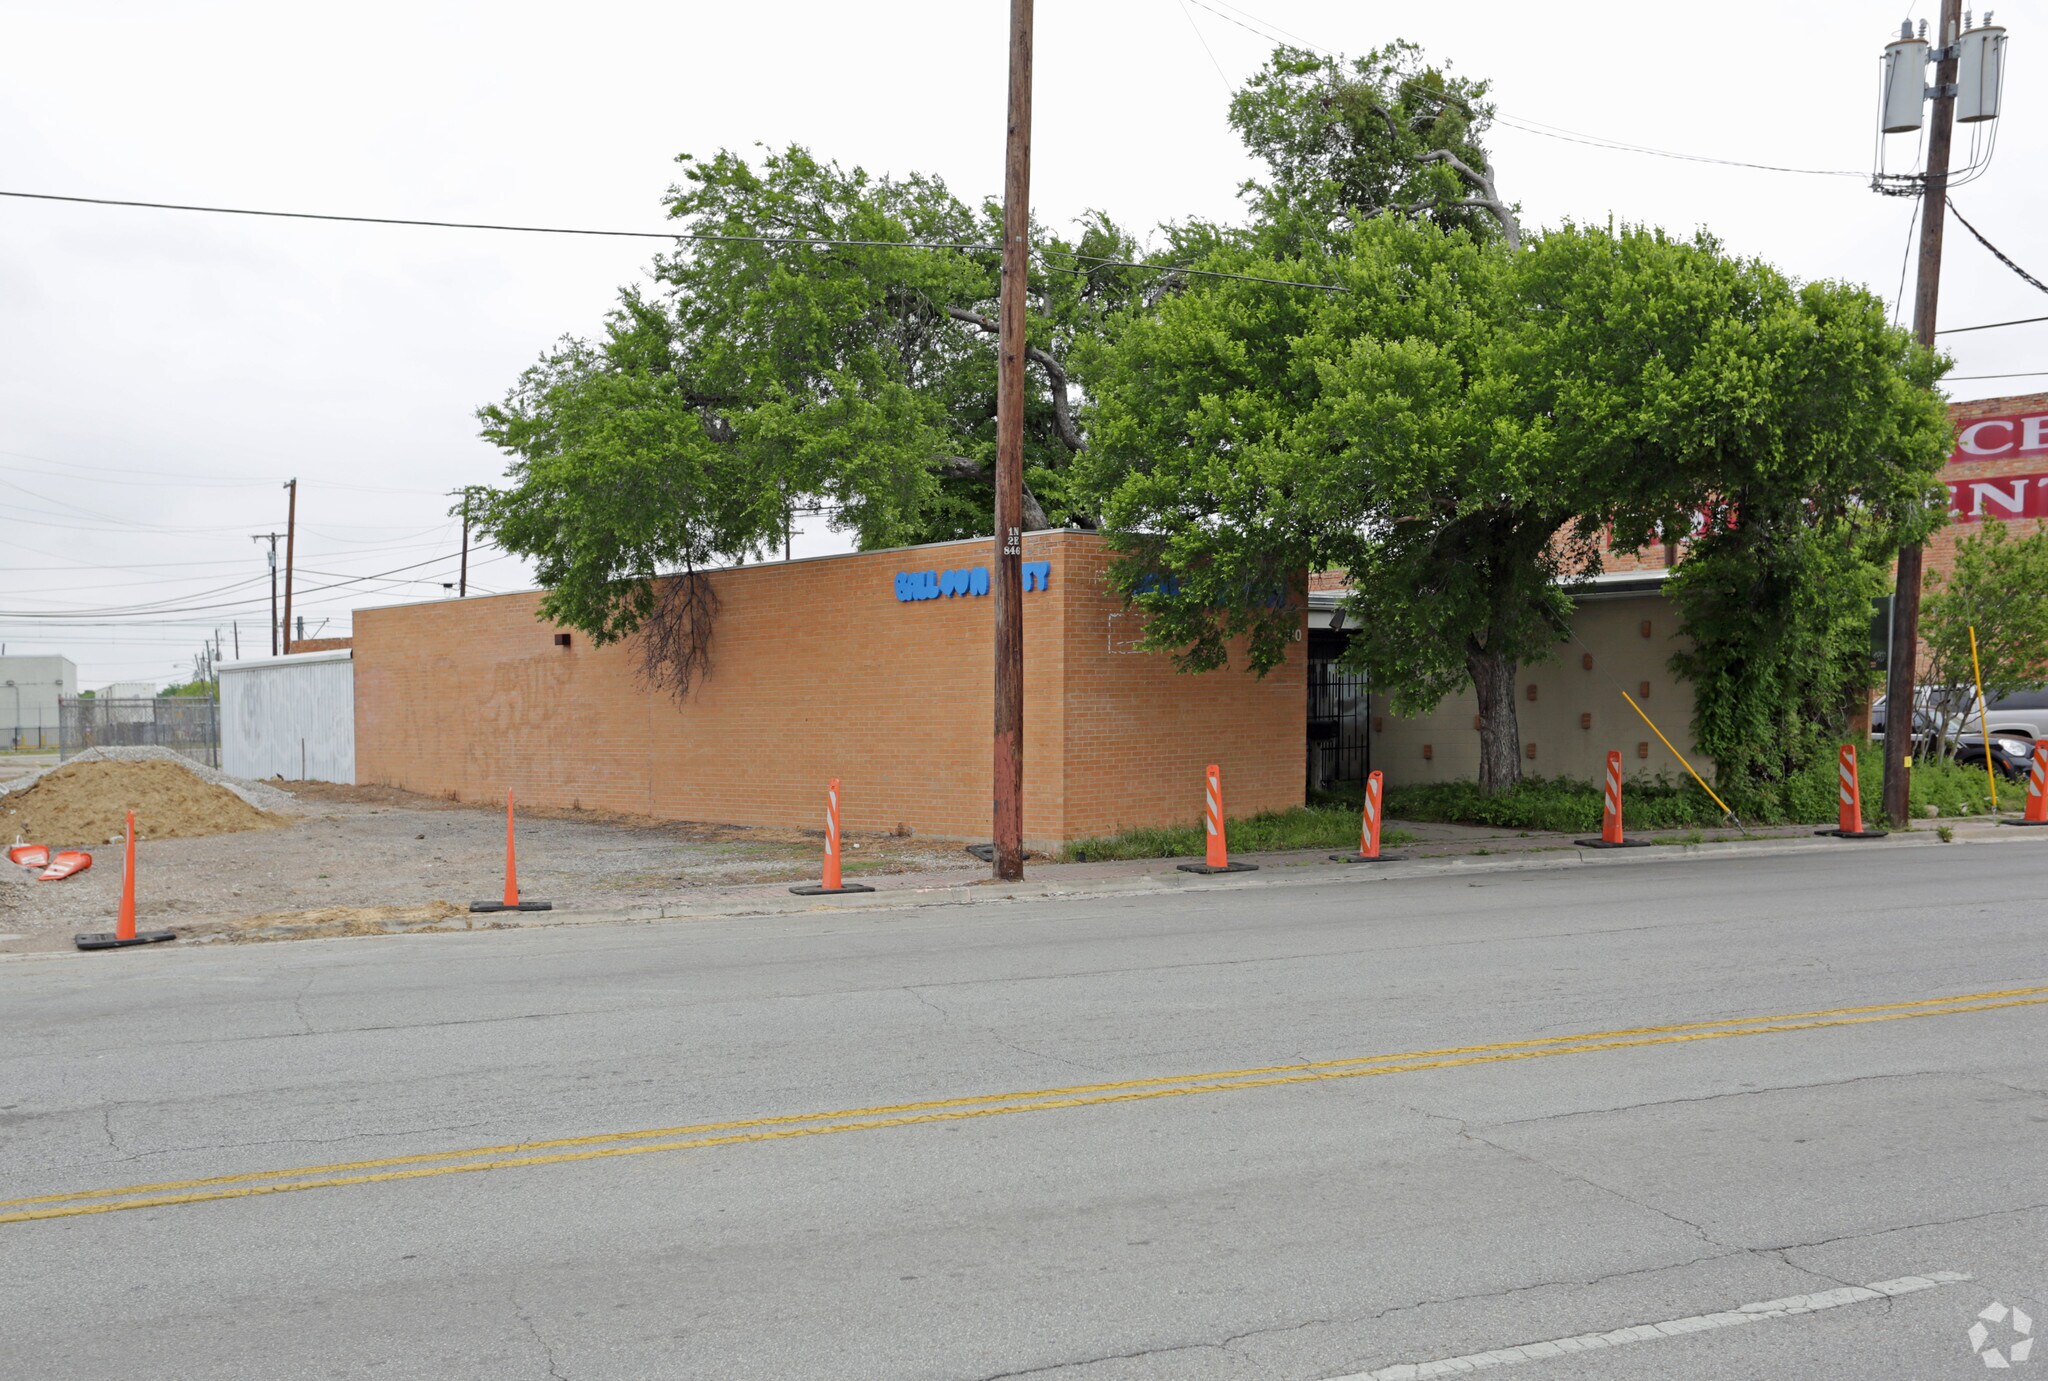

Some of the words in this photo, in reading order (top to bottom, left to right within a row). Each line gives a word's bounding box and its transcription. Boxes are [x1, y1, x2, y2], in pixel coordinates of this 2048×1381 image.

[1008, 526, 1020, 536] 1N
[1007, 536, 1020, 546] 2E
[1003, 546, 1021, 555] 846
[894, 566, 990, 602] BALLOON
[1021, 560, 1051, 593] TY
